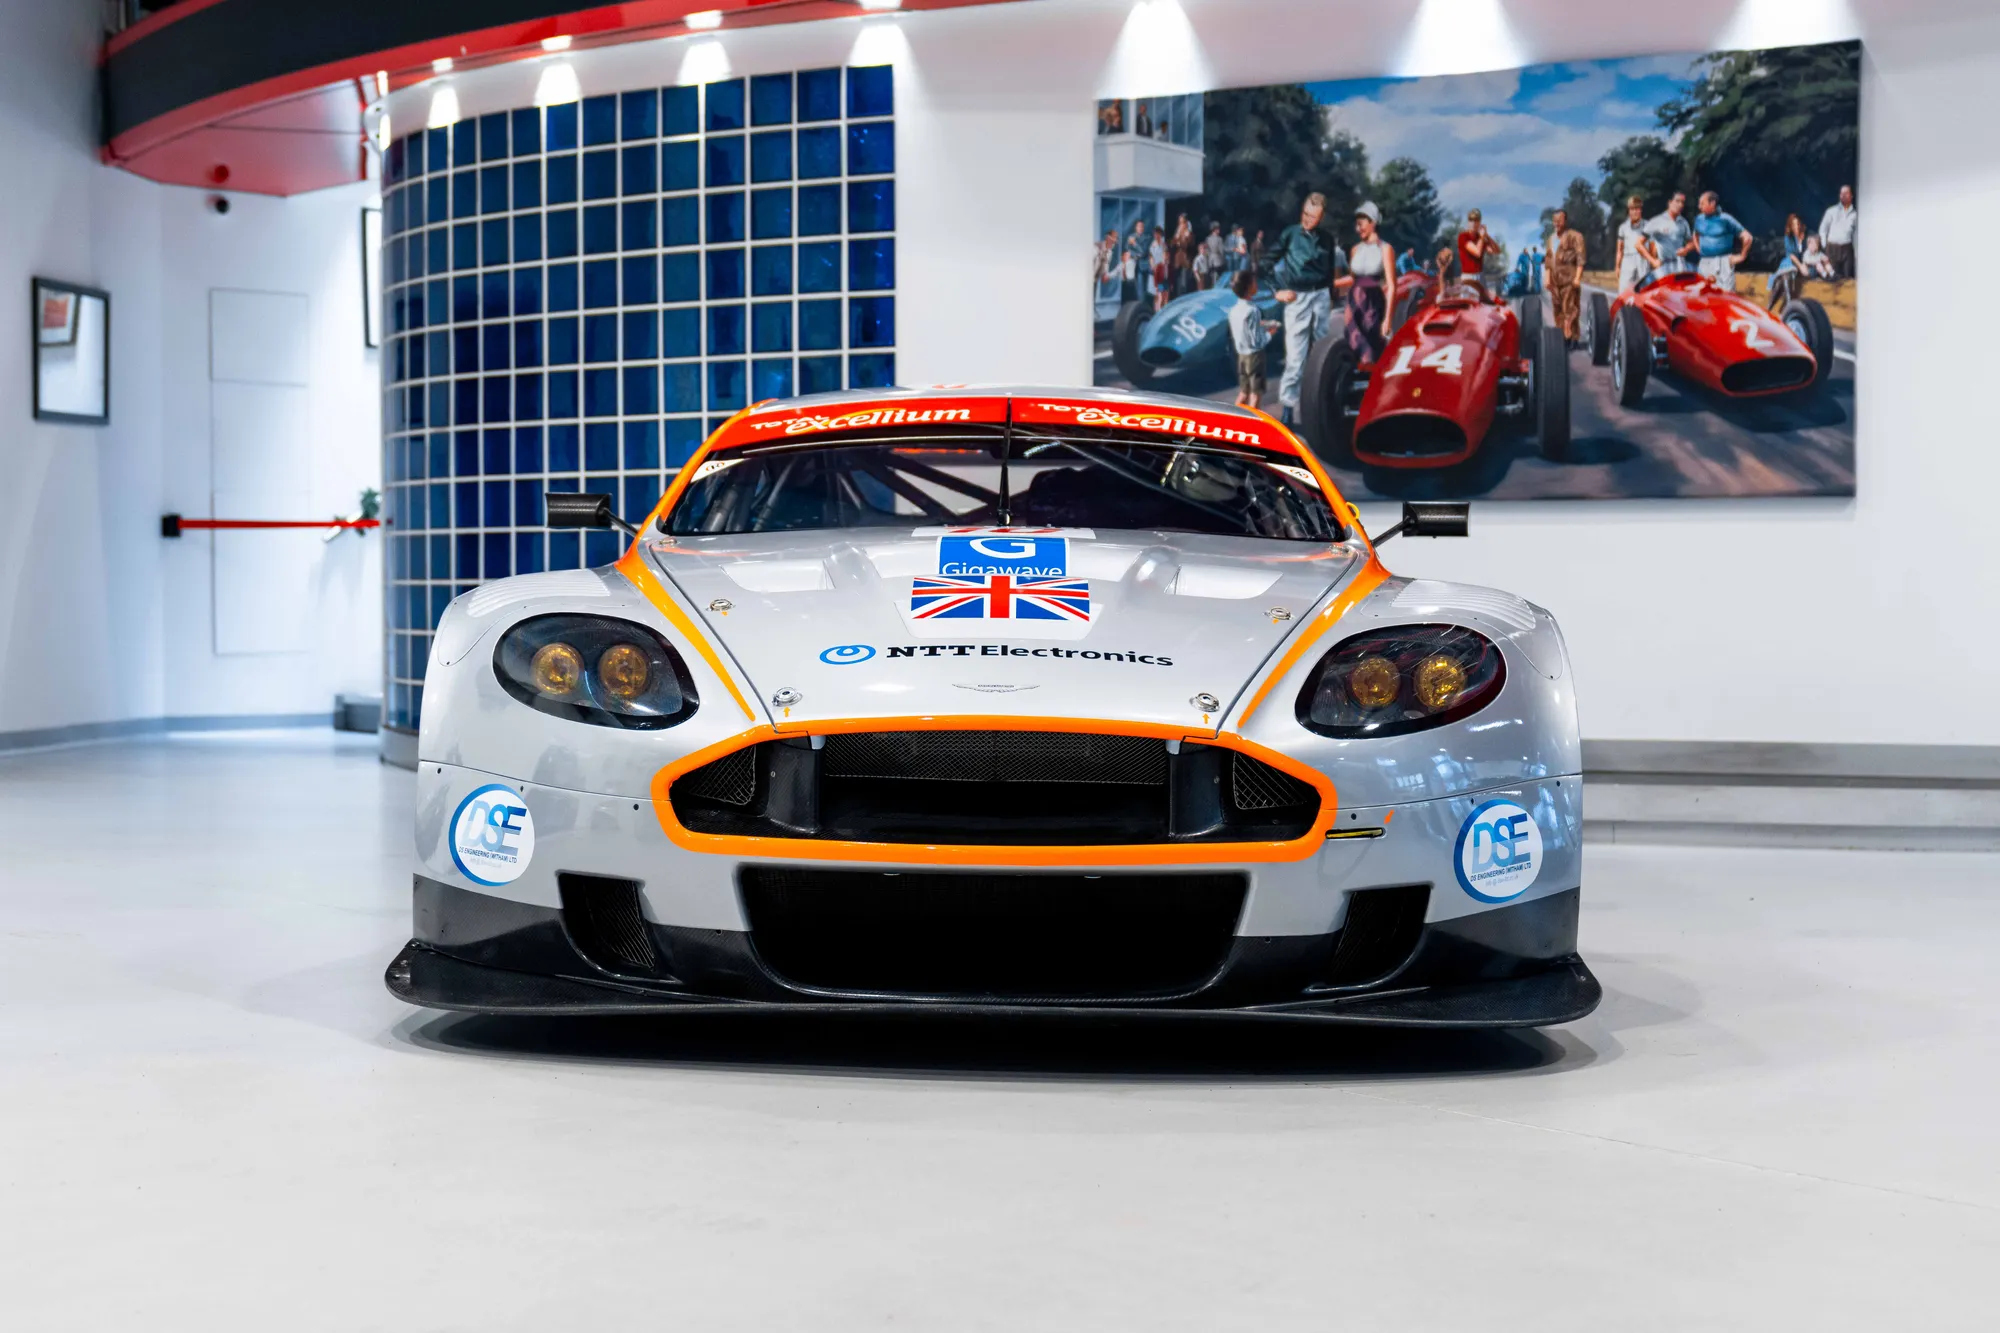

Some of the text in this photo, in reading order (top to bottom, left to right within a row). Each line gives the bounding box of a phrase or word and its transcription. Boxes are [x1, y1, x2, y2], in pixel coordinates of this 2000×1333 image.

[1172, 316, 1207, 341] 18
[1730, 318, 1774, 349] 2
[1384, 344, 1463, 378] 14
[785, 408, 970, 435] excellium
[1076, 411, 1261, 445] excellium
[969, 537, 1036, 559] G
[886, 645, 1174, 667] NTT Electronics
[1472, 813, 1531, 874] DSE
